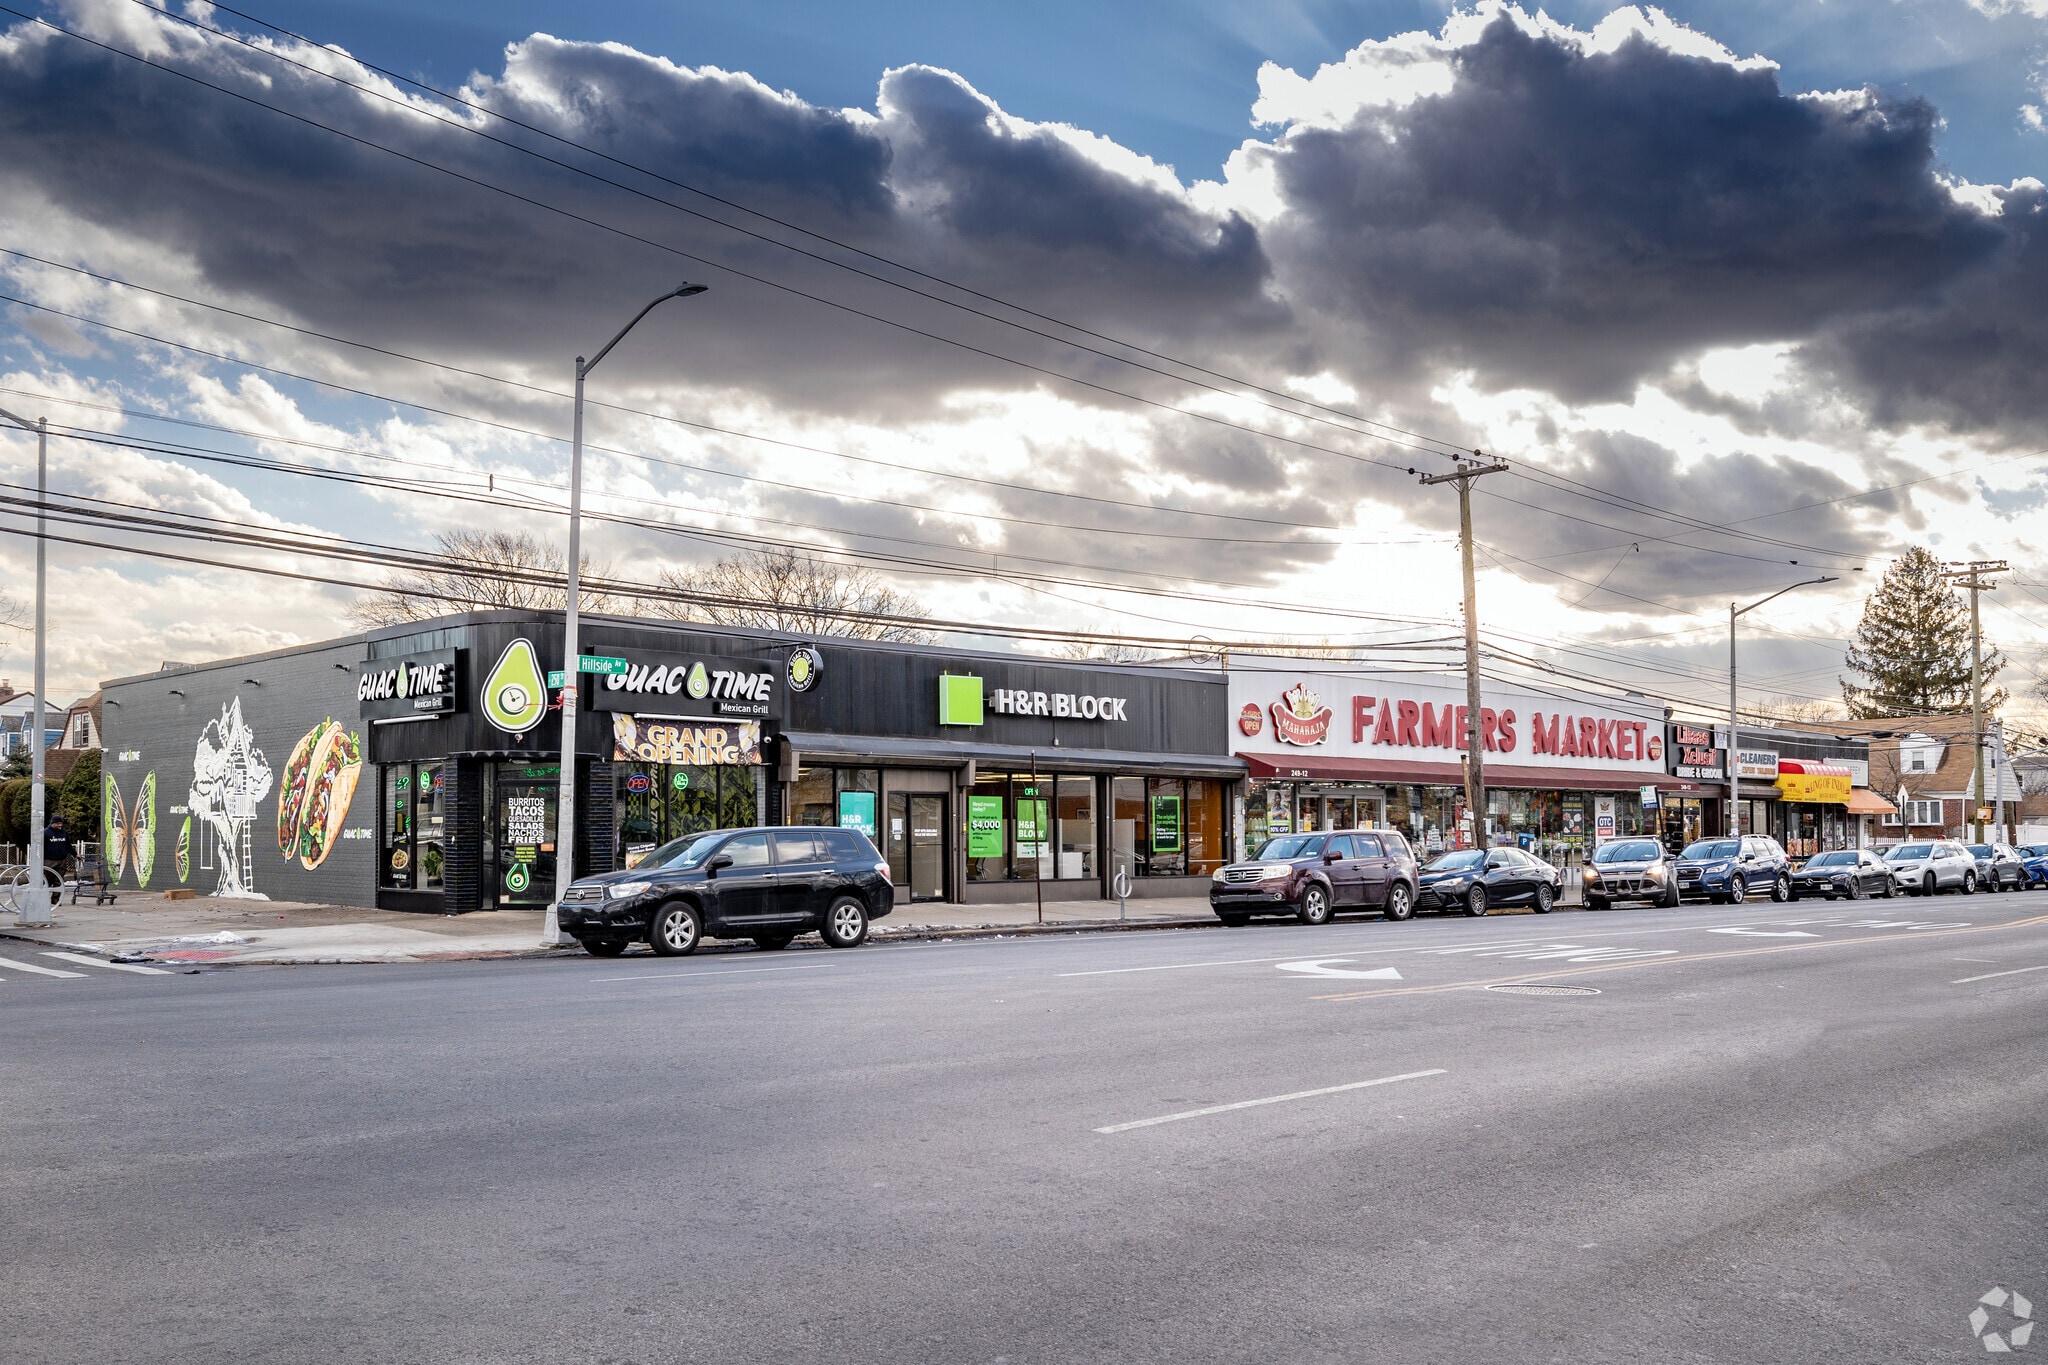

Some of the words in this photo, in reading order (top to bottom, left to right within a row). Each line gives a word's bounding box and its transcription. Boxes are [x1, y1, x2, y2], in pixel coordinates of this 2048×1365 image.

[582, 658, 612, 672] Hillside
[790, 652, 802, 666] GUAC
[802, 652, 812, 664] TIME
[357, 669, 396, 701] GUAC
[409, 663, 444, 696] TIME
[711, 670, 774, 700] TIME
[414, 700, 432, 709] Mexican
[432, 698, 442, 706] Grill
[720, 703, 751, 714] Mexican
[752, 705, 768, 714] Grill
[996, 689, 1049, 716] H&R
[1051, 693, 1127, 722] BLOCK
[1244, 720, 1260, 730] OPEN
[1282, 718, 1326, 736] MAHARAJA
[1352, 695, 1516, 752] FARMERS
[1533, 712, 1646, 760] MARKET
[647, 726, 728, 747] GRAND
[638, 744, 739, 764] OPENING
[1740, 753, 1776, 766] CLEANERS
[1676, 766, 1696, 778] BRIDE
[1696, 768, 1701, 778] &
[1702, 768, 1722, 778] GROOM
[627, 778, 650, 789] OPEN
[508, 798, 544, 806] BURRITOS
[508, 806, 544, 816] TACOS
[842, 814, 862, 824] H&R
[972, 820, 1000, 830] $4,000
[1599, 818, 1612, 826] OTC
[344, 828, 357, 839] GUAC
[360, 828, 372, 838] TIME
